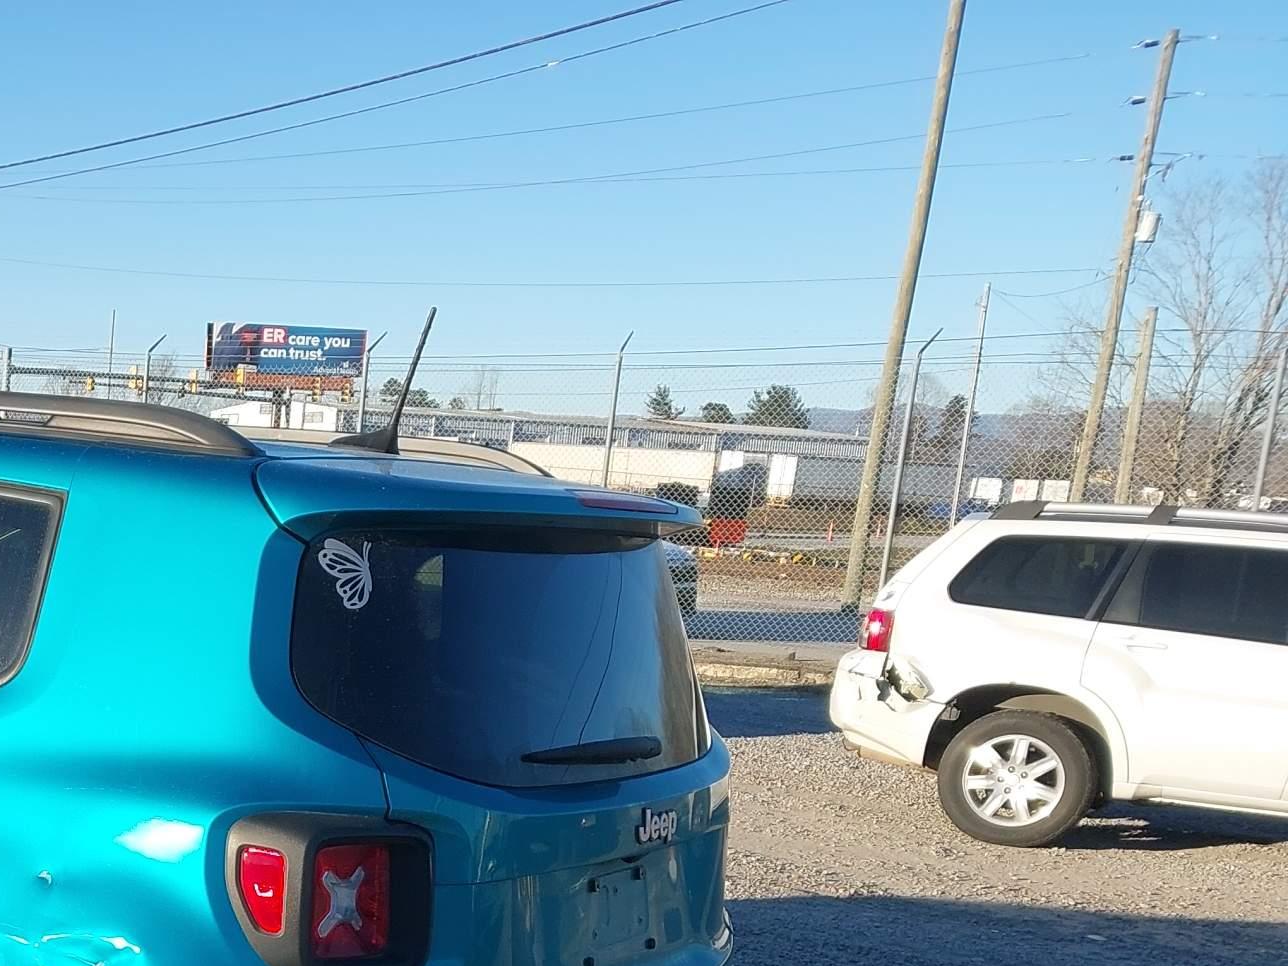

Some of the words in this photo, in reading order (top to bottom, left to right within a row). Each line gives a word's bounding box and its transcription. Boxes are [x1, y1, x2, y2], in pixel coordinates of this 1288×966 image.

[263, 328, 285, 343] ER
[288, 335, 320, 346] care
[323, 336, 350, 350] you
[260, 348, 287, 358] can
[289, 347, 326, 360] trust.
[639, 807, 677, 842] Jeep
